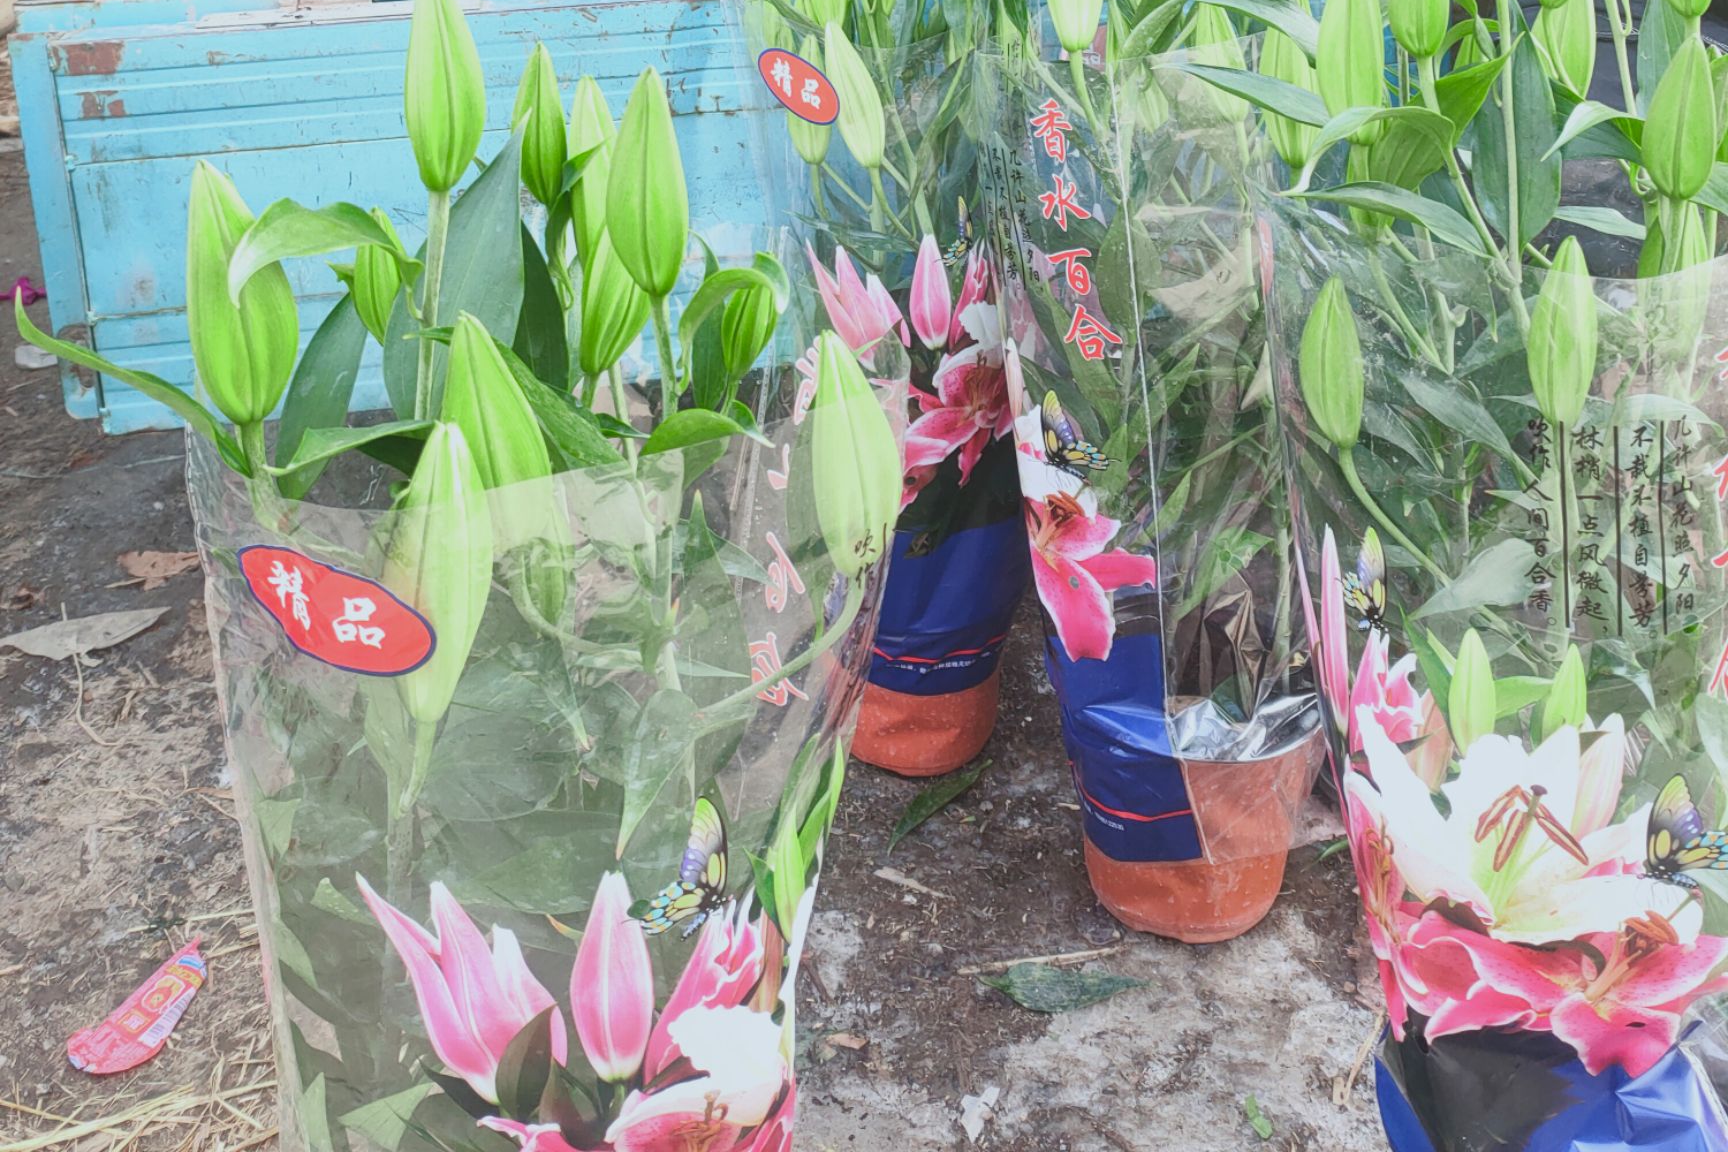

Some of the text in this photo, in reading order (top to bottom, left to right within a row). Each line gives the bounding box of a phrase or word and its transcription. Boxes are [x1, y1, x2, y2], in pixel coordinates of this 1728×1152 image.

[769, 56, 822, 111] 精品
[1029, 98, 1123, 362] 香水百合
[266, 559, 386, 650] 精品
